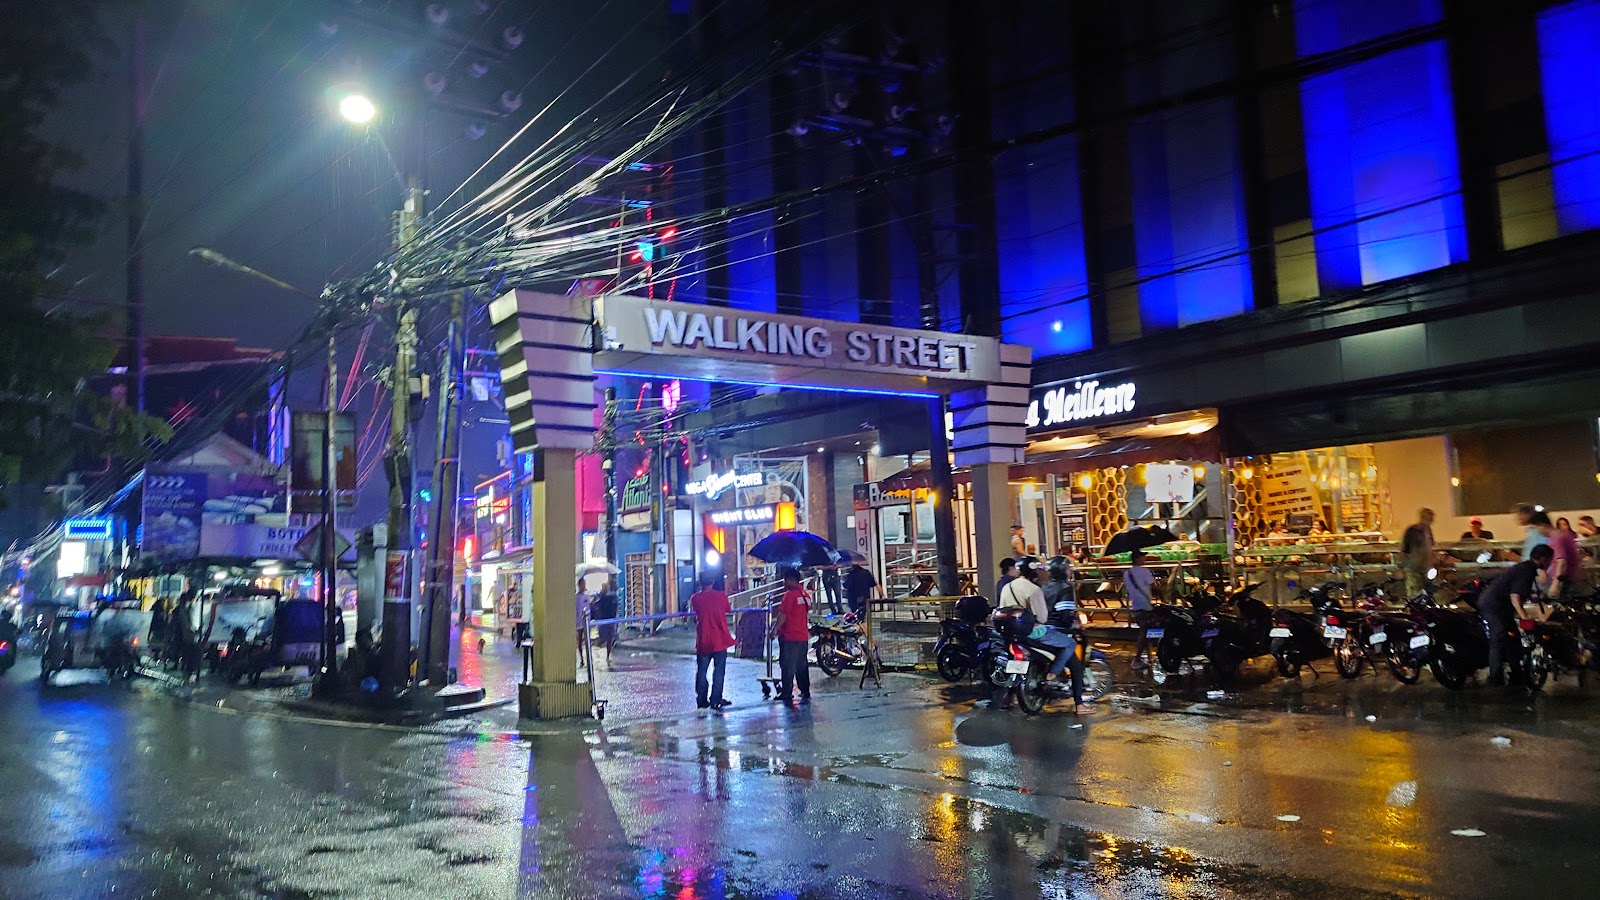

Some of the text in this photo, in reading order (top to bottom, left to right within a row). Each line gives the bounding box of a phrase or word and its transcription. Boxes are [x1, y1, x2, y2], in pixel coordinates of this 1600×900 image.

[643, 306, 977, 371] WALKING STREET
[1025, 399, 1040, 427] a
[734, 472, 763, 488] CENTER
[711, 507, 773, 523] NIGHT CLUB
[857, 518, 869, 556] 나이
